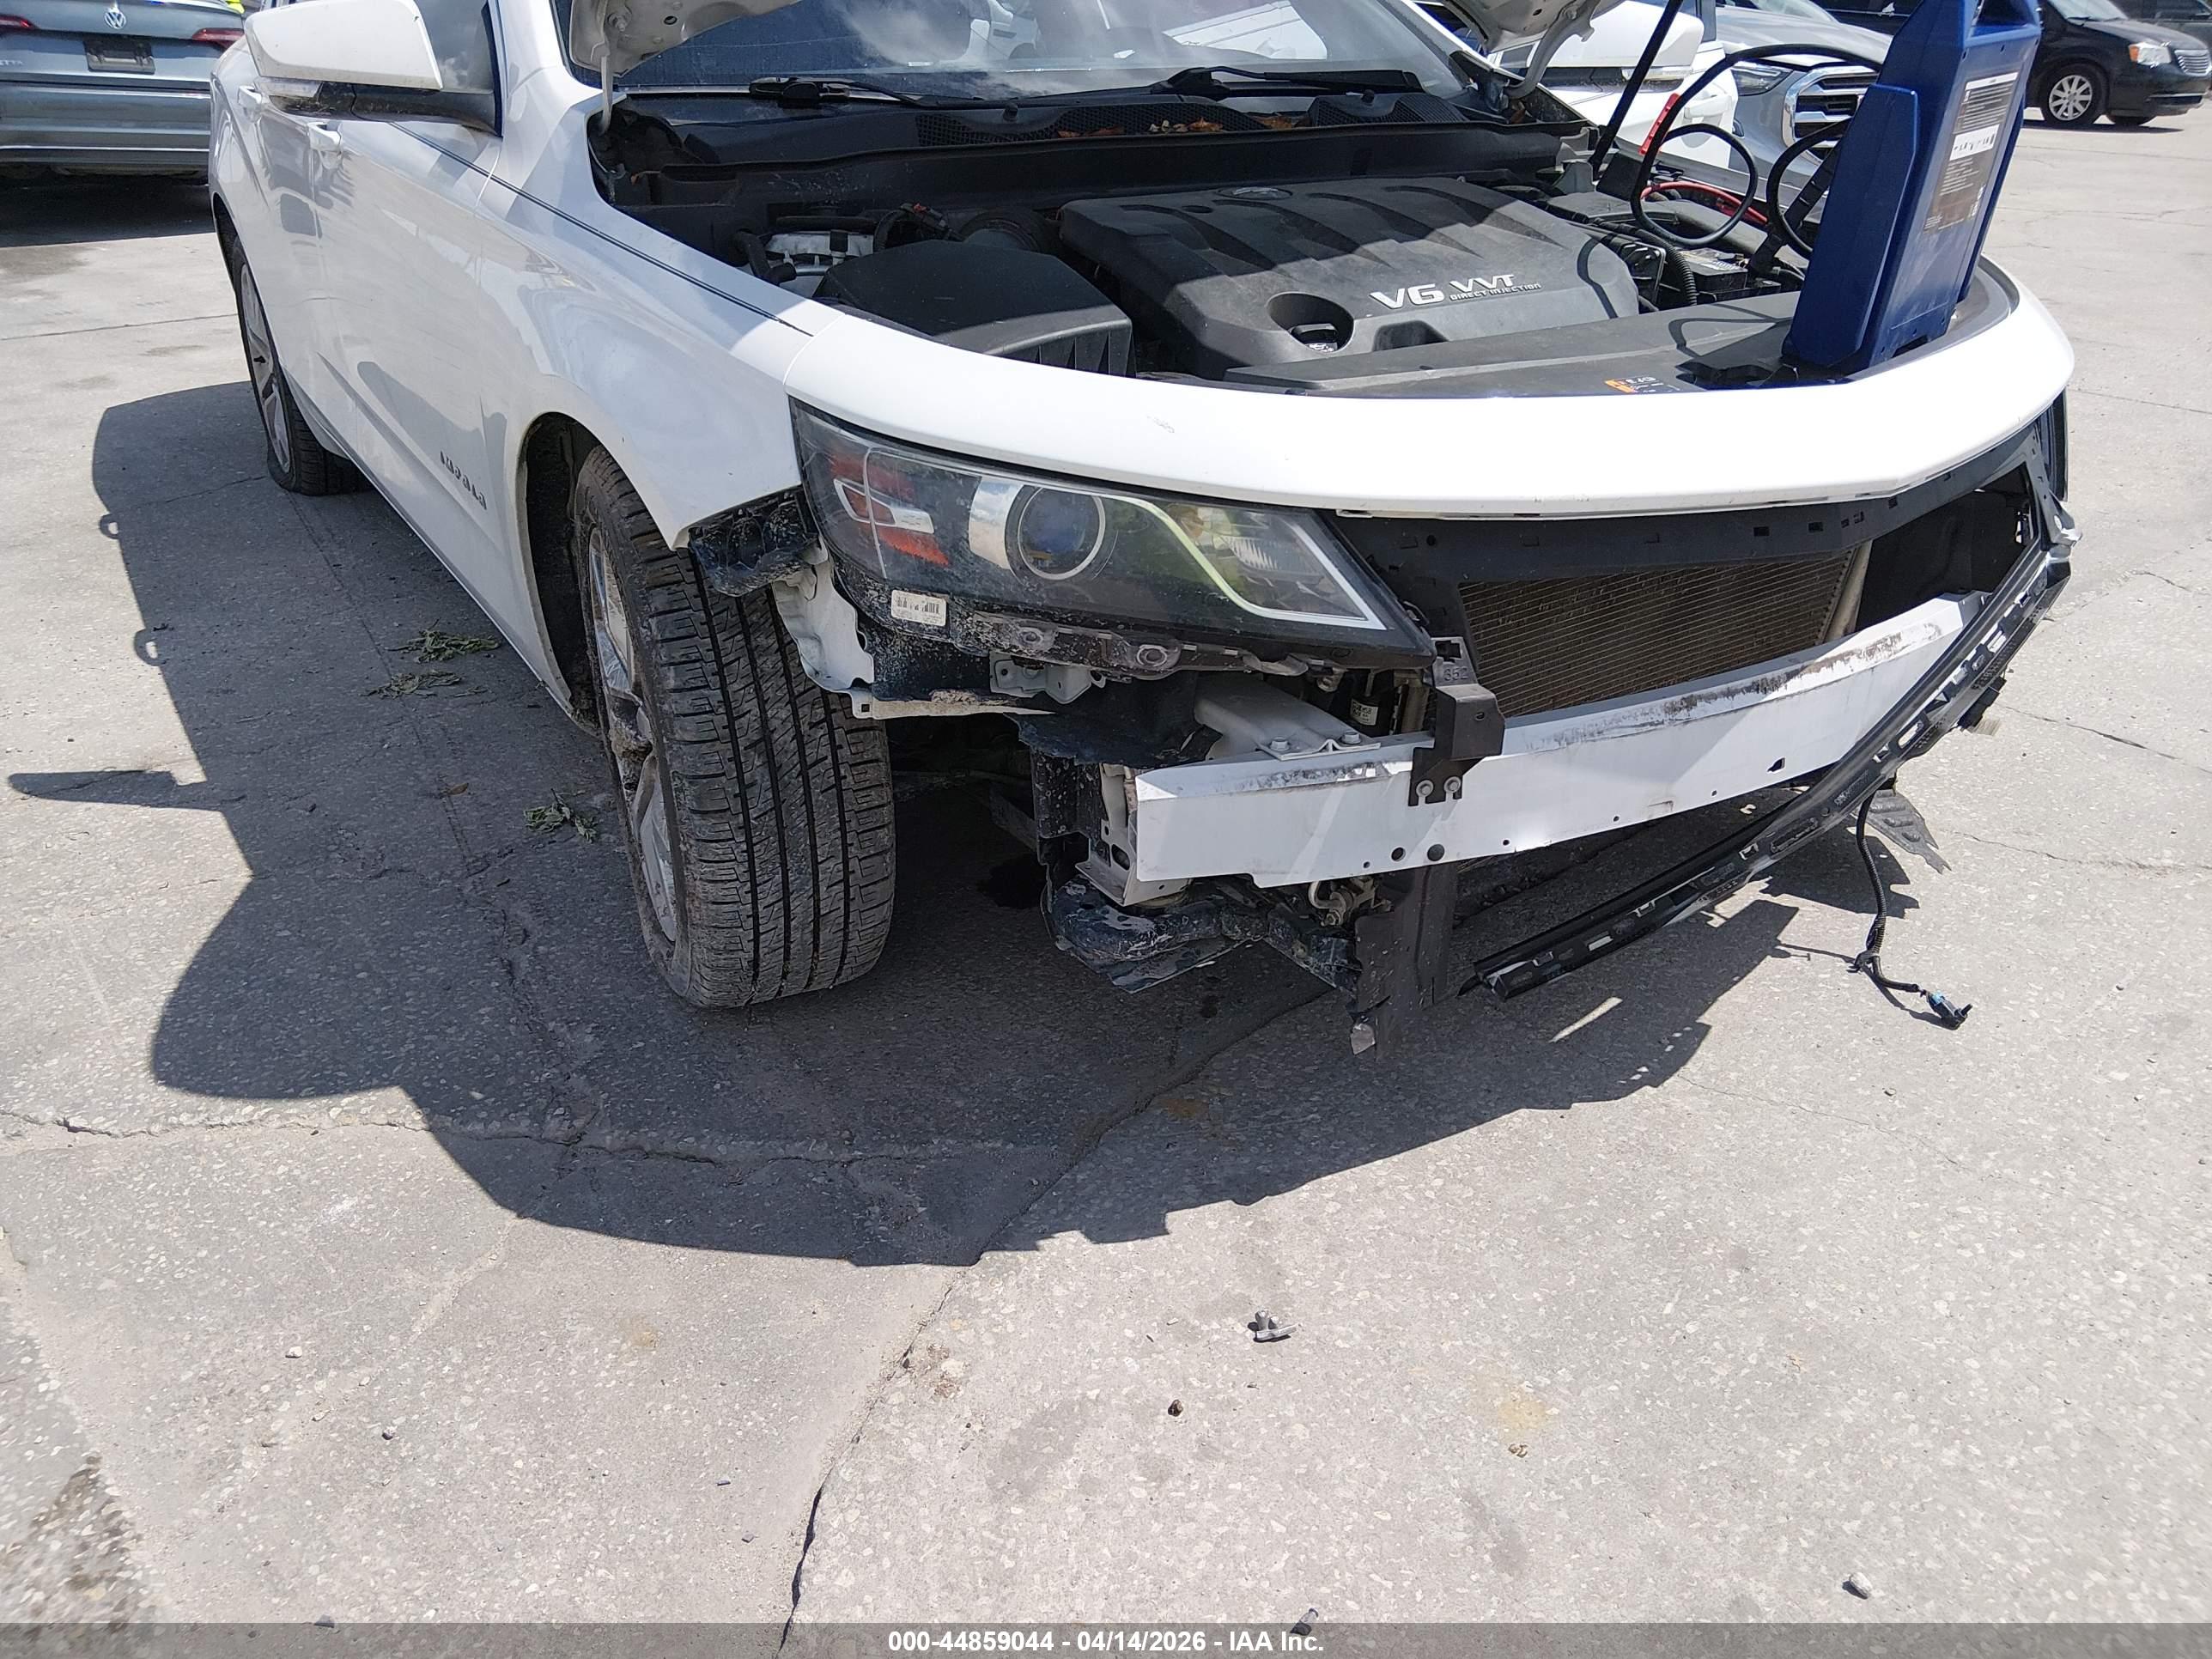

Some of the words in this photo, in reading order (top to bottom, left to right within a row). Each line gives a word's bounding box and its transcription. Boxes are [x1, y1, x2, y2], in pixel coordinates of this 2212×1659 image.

[1369, 283, 1444, 309] V6
[1449, 274, 1515, 293] VVT
[1449, 290, 1488, 301] DIRECT
[1489, 283, 1542, 296] INJECTION
